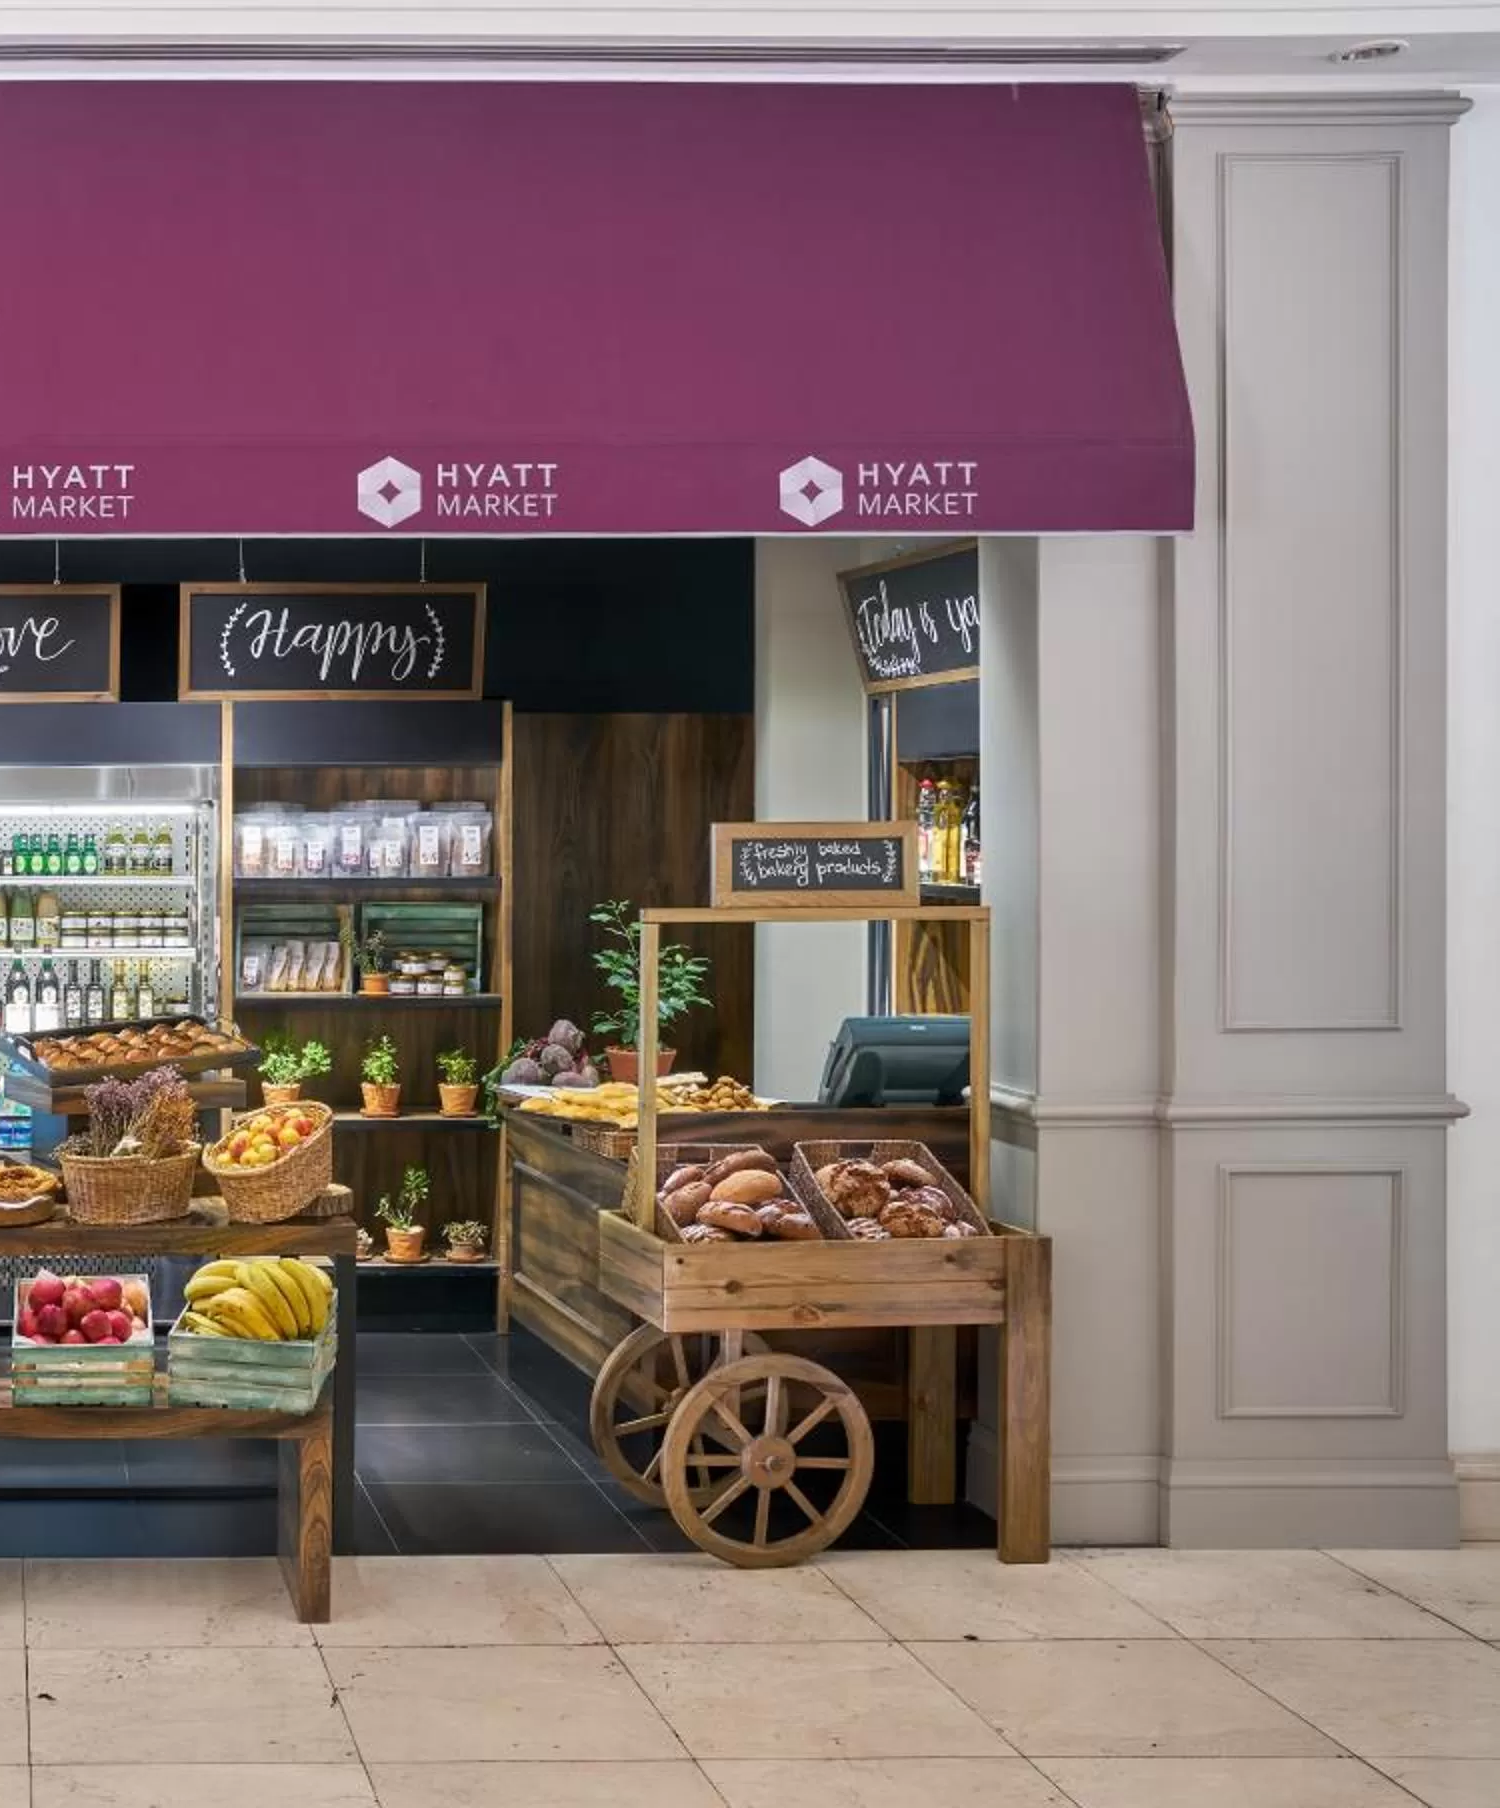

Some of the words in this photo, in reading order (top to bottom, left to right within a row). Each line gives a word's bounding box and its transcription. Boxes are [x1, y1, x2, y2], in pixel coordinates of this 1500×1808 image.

[13, 465, 135, 489] HYATT
[437, 463, 557, 487] HYATT
[857, 462, 977, 486] HYATT
[12, 495, 134, 518] MARKET
[437, 493, 557, 516] MARKET
[858, 492, 978, 515] MARKET
[245, 607, 431, 681] Happy
[754, 842, 808, 864] freshly
[818, 841, 861, 855] baked
[758, 857, 809, 886] bakery
[816, 857, 881, 884] products
